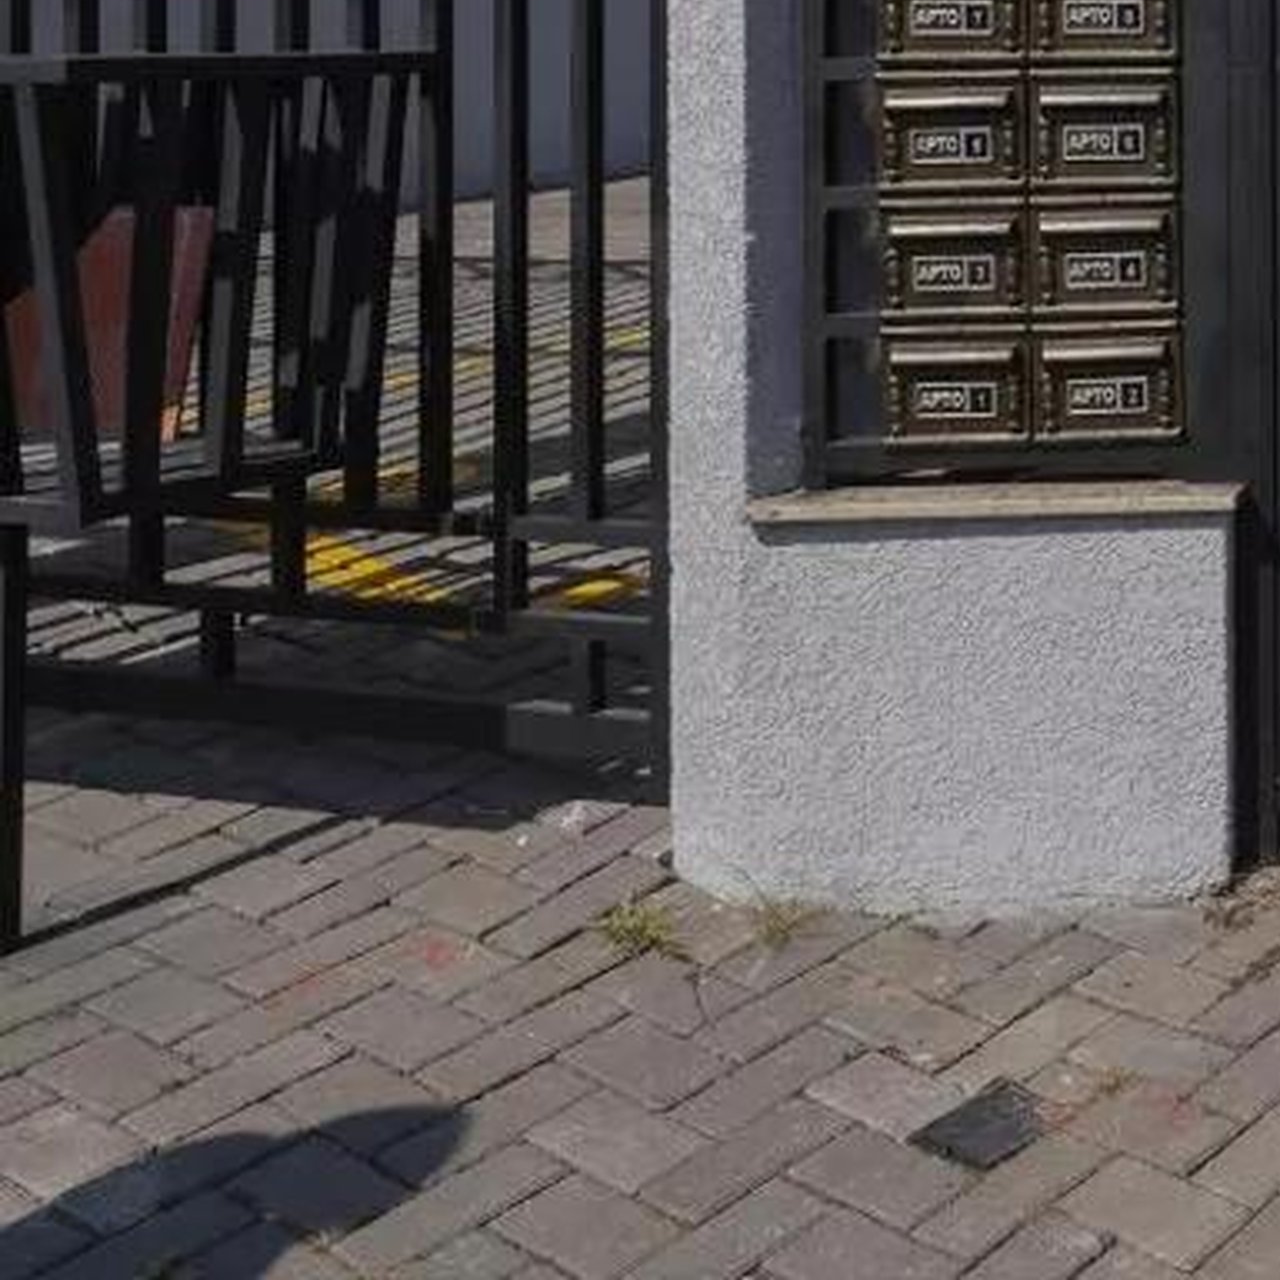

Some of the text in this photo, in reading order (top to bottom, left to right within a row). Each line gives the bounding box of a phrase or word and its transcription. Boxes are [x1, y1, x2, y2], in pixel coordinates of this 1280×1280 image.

[915, 7, 959, 25] APTO
[1069, 6, 1112, 23] APTO
[915, 134, 959, 152] APTO
[1069, 133, 1111, 151] APTO
[917, 263, 962, 281] APTO
[1068, 261, 1112, 278] APTO
[918, 390, 965, 408] APTO
[1072, 386, 1115, 404] APTO
